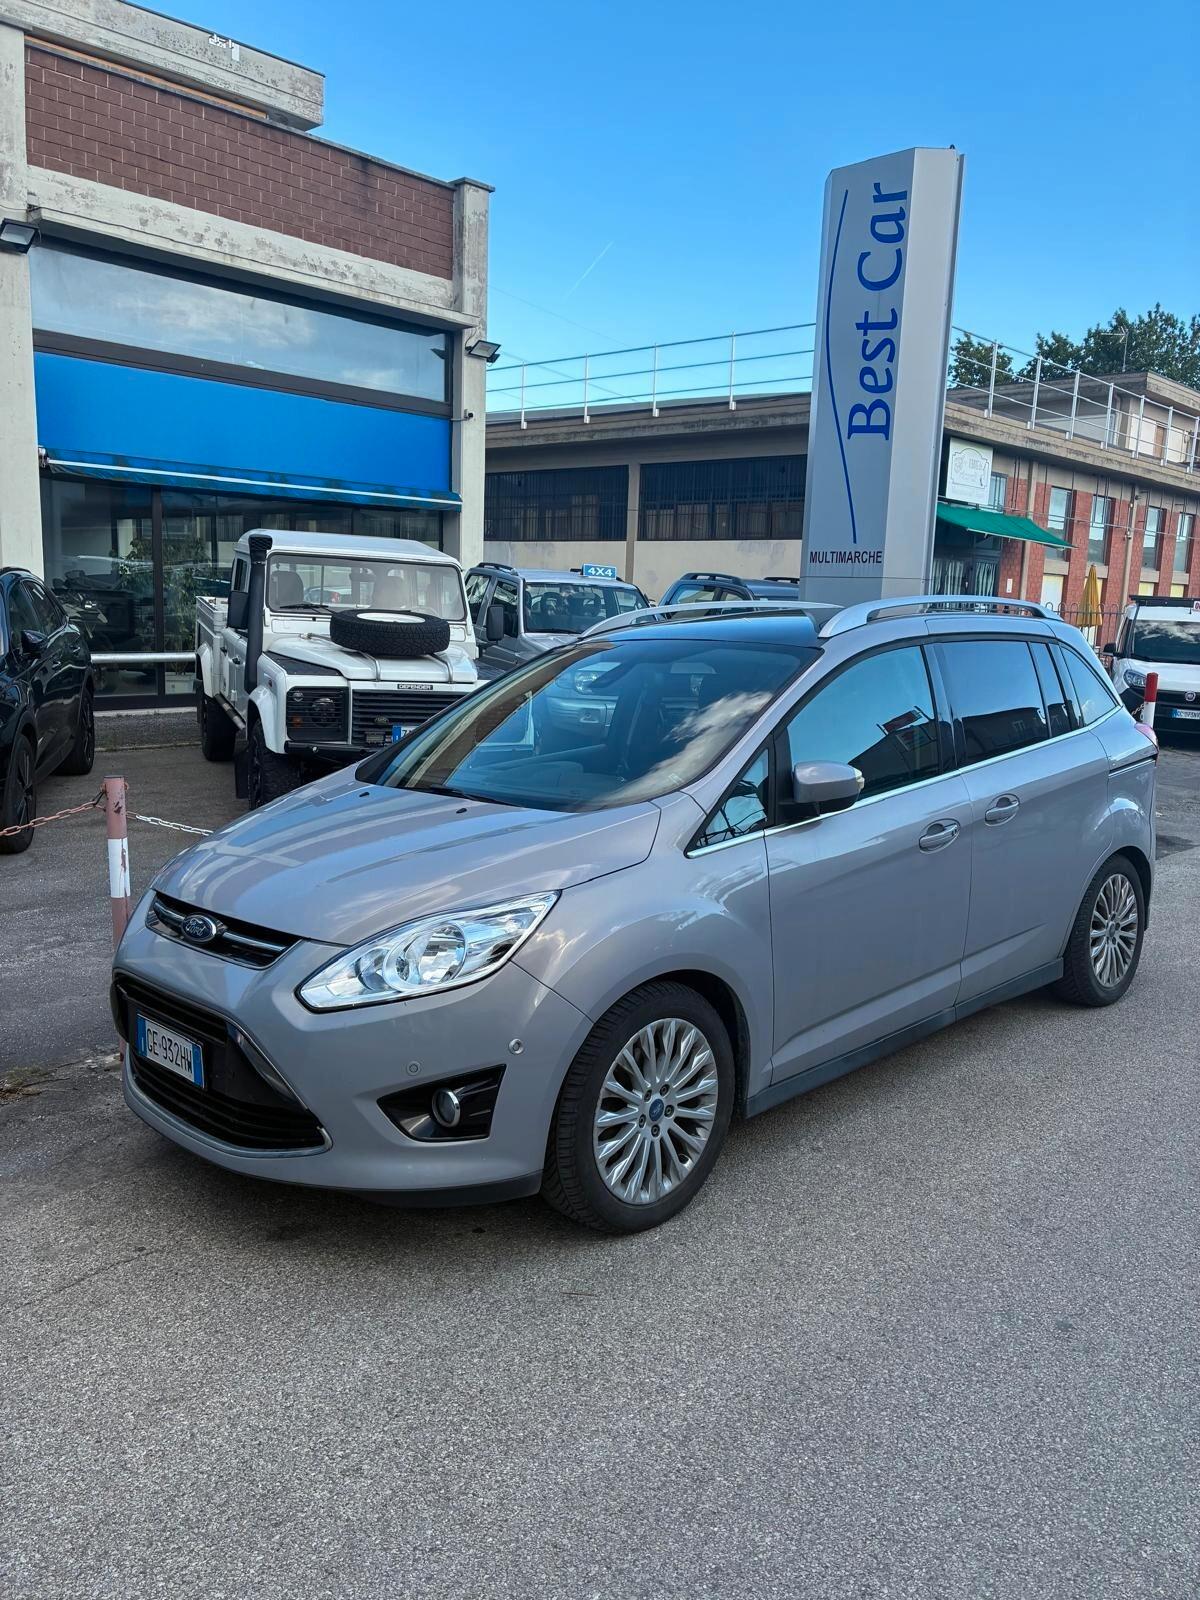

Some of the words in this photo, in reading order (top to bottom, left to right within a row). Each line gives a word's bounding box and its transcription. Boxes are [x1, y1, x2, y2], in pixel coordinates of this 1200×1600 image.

[857, 182, 908, 291] Car
[847, 307, 898, 440] Best
[588, 567, 613, 577] 4X4
[809, 551, 883, 564] MULTIMARCHE
